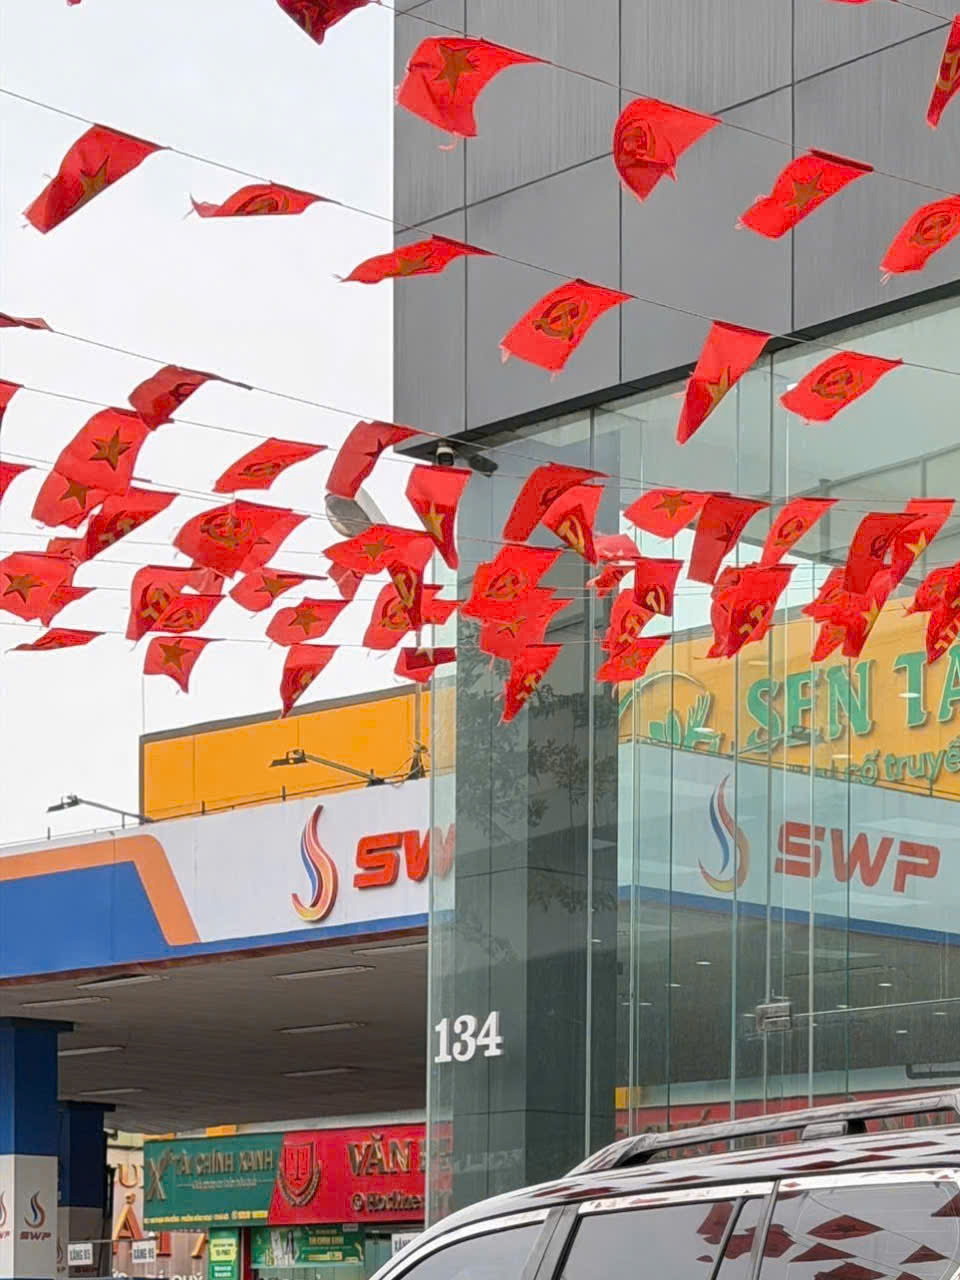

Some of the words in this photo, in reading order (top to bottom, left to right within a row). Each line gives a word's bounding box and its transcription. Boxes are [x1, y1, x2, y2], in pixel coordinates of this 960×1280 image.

[353, 824, 456, 889] SW
[774, 821, 941, 893] SWP
[434, 1011, 503, 1063] 134
[347, 1132, 412, 1176] VĂN
